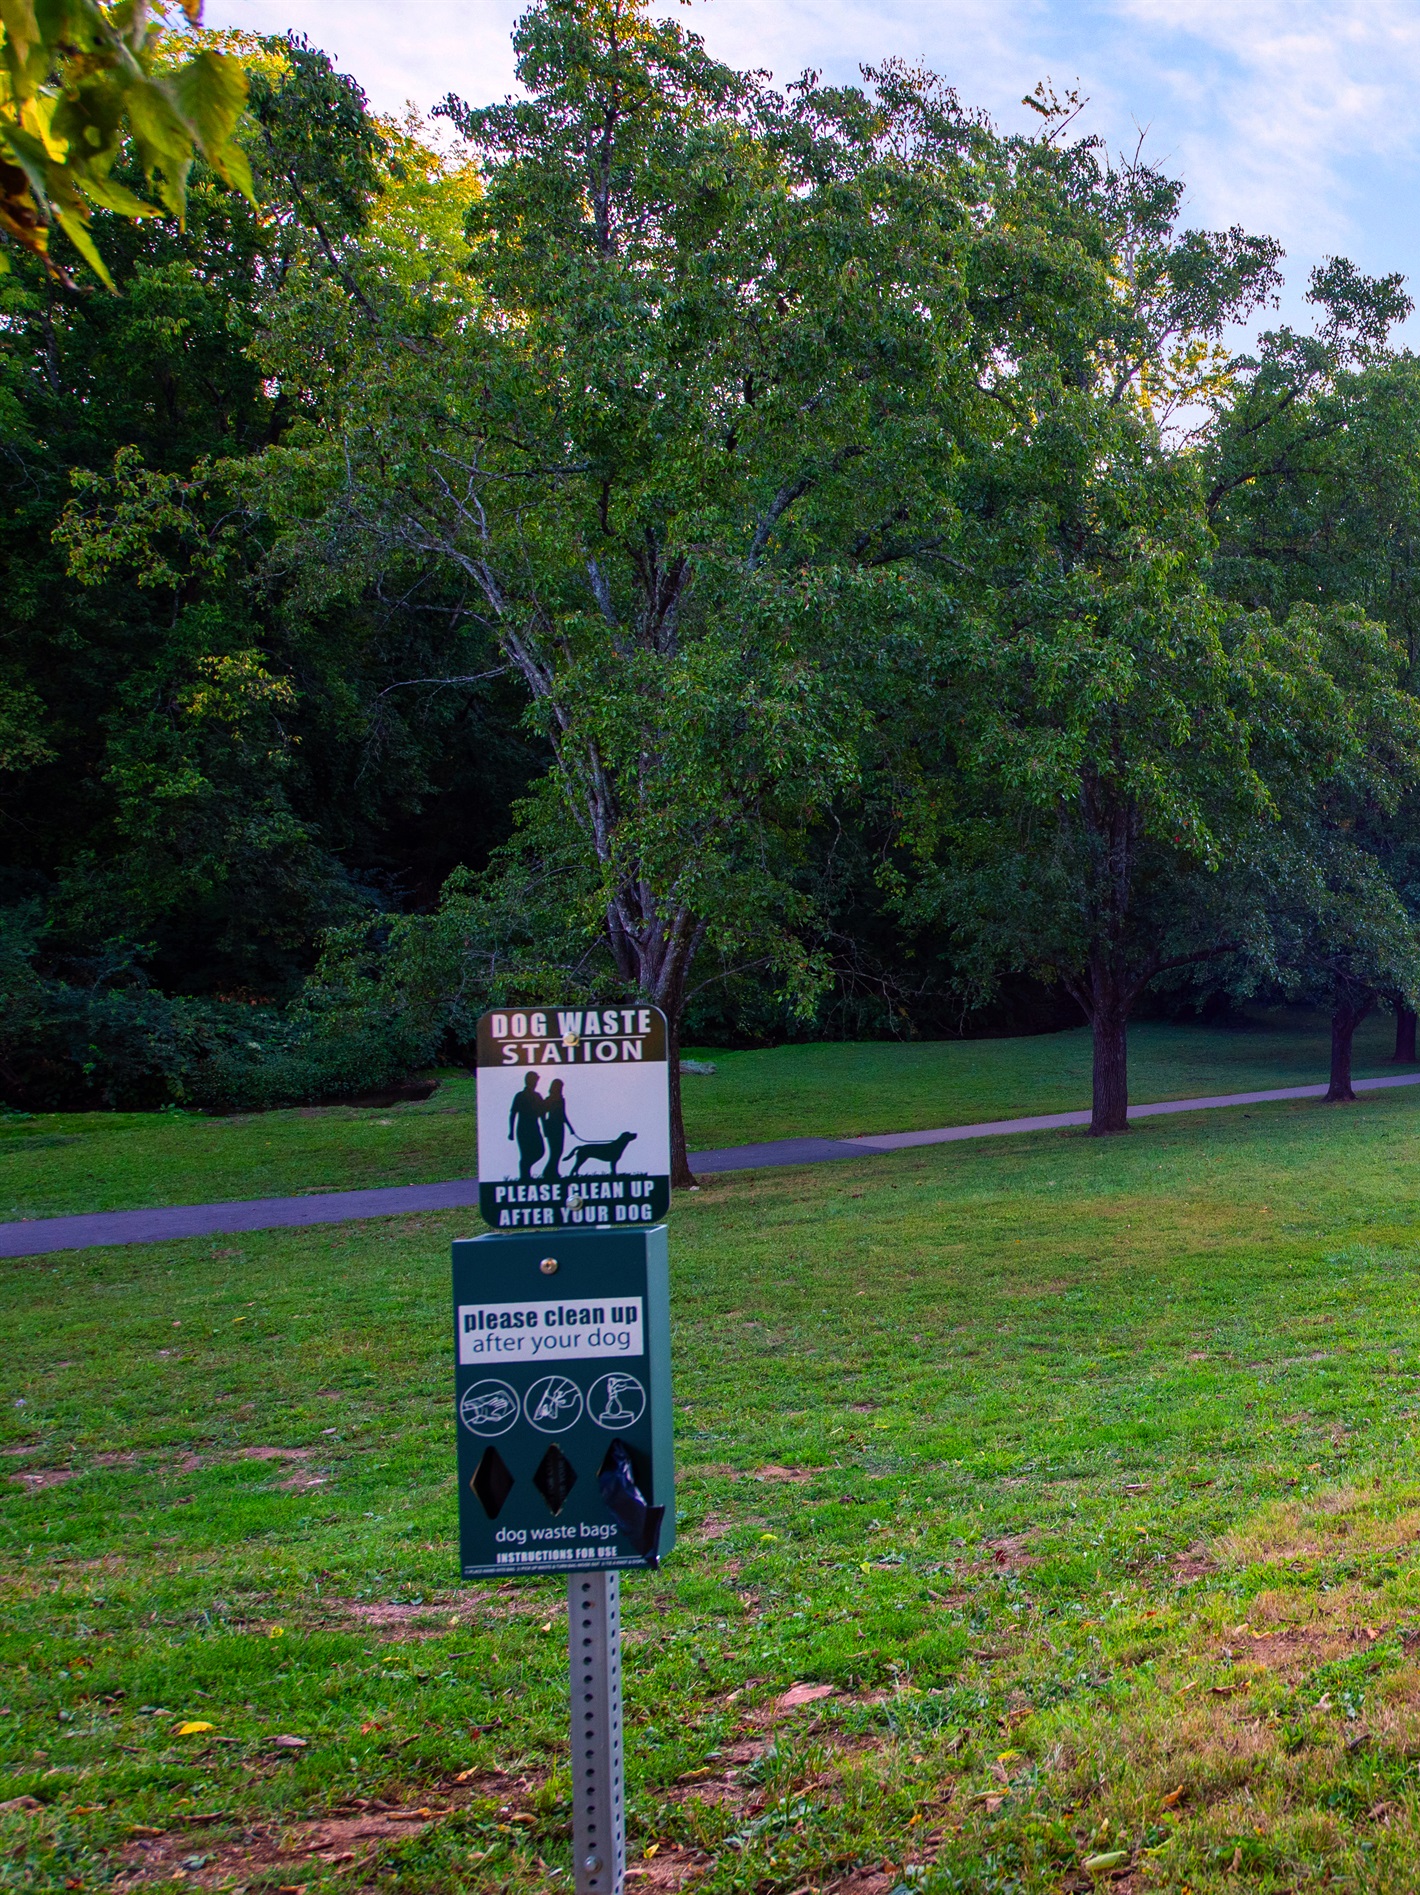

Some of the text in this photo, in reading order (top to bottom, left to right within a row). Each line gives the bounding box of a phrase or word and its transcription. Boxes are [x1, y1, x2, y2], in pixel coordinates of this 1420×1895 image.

[491, 1009, 651, 1038] DOG WASTE
[502, 1040, 643, 1064] STATION
[495, 1180, 654, 1203] PLEASE CLEAN UP
[499, 1203, 653, 1226] AFTER YOUR DOG
[464, 1305, 638, 1332] please clean up
[473, 1328, 631, 1355] after your dog
[495, 1521, 618, 1545] dog waste bags
[496, 1545, 618, 1564] INSTRUCTIONS FOR USE
